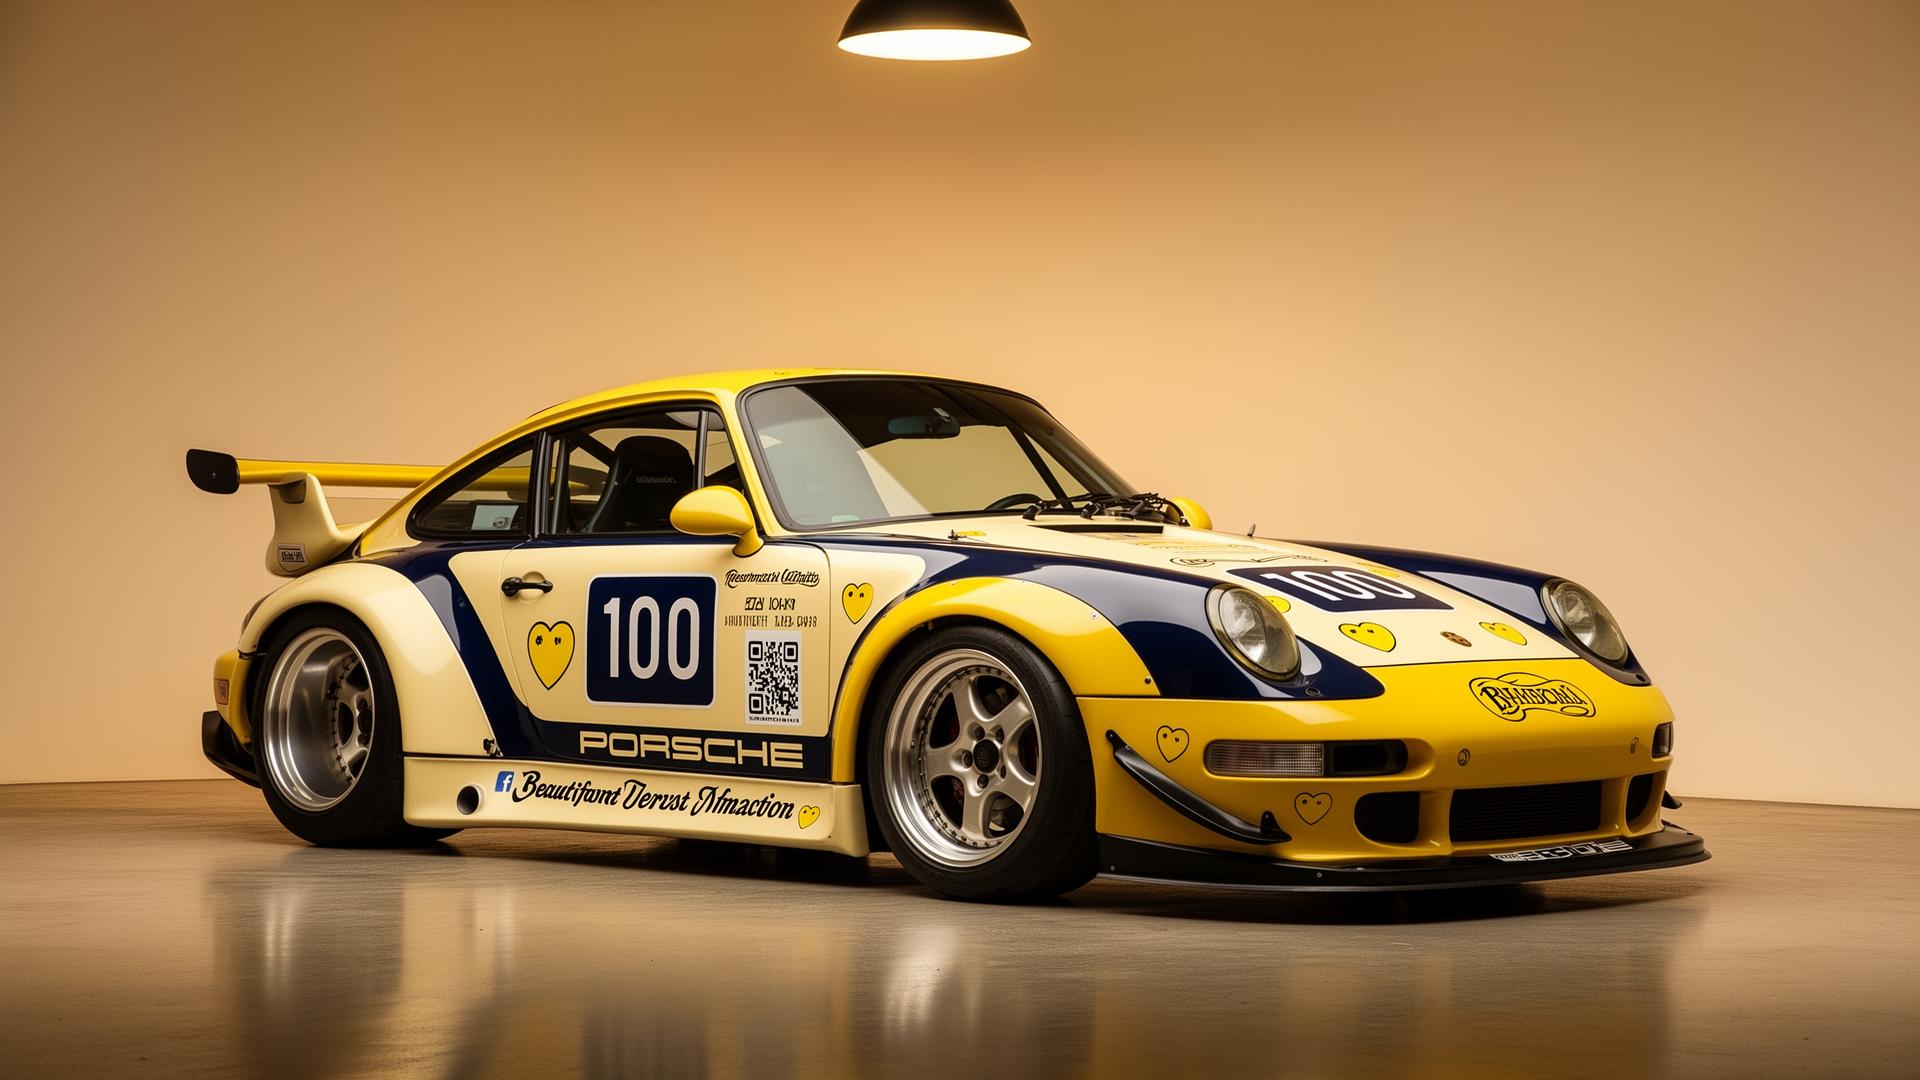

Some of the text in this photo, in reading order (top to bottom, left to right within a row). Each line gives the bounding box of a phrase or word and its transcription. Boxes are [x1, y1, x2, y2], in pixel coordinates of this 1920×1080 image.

[1259, 570, 1416, 601] 100
[603, 595, 700, 680] 100
[579, 730, 804, 769] PORSCHE
